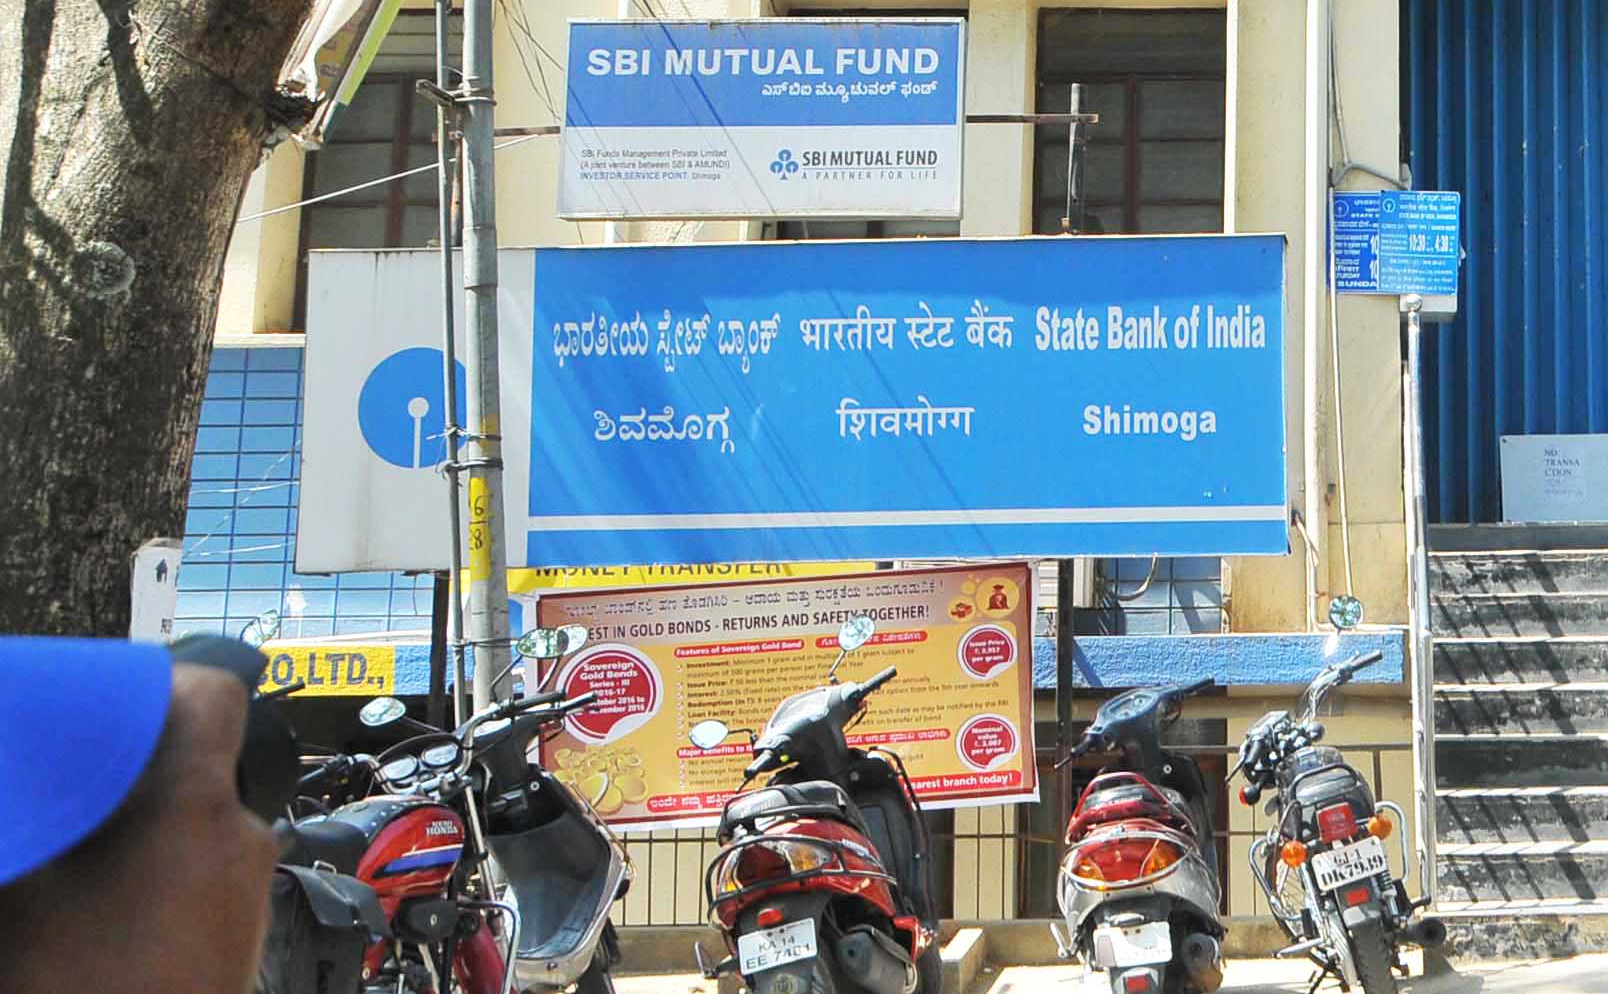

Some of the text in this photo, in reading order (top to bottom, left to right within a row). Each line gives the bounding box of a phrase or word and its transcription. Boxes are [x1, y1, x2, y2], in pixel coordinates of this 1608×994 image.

[586, 48, 939, 76] SBI MUTUAL FUND
[802, 150, 938, 167] SBI MUTUAL FUND
[801, 170, 937, 180] A PARTNER FOR LIFE
[799, 299, 1015, 351] भारतीय स्टेट बैंक
[1034, 304, 1266, 351] State Bank of India
[553, 309, 782, 374] ಭಾರತೀಯ ಸ್ಟೇಟ್ ಬ್ಯಾಂಕ್
[835, 394, 976, 441] शिवमोग्ग
[1083, 404, 1217, 442] Shimoga
[593, 405, 736, 454] ಶಿವಮೊಗ್ಗ
[1544, 448, 1558, 457] NO
[1544, 458, 1581, 467] TRANSA
[587, 605, 930, 641] EST IN GOLD BONDS RETURNS AND SAFETY TOGETHER!
[676, 640, 802, 657] Features of Sovereign Gold Bond
[583, 661, 635, 672] Sovereign
[580, 670, 639, 681] Gold Bonds
[589, 680, 615, 688] Series
[678, 748, 701, 758] Major
[943, 774, 977, 787] branch
[979, 772, 1014, 786] today!
